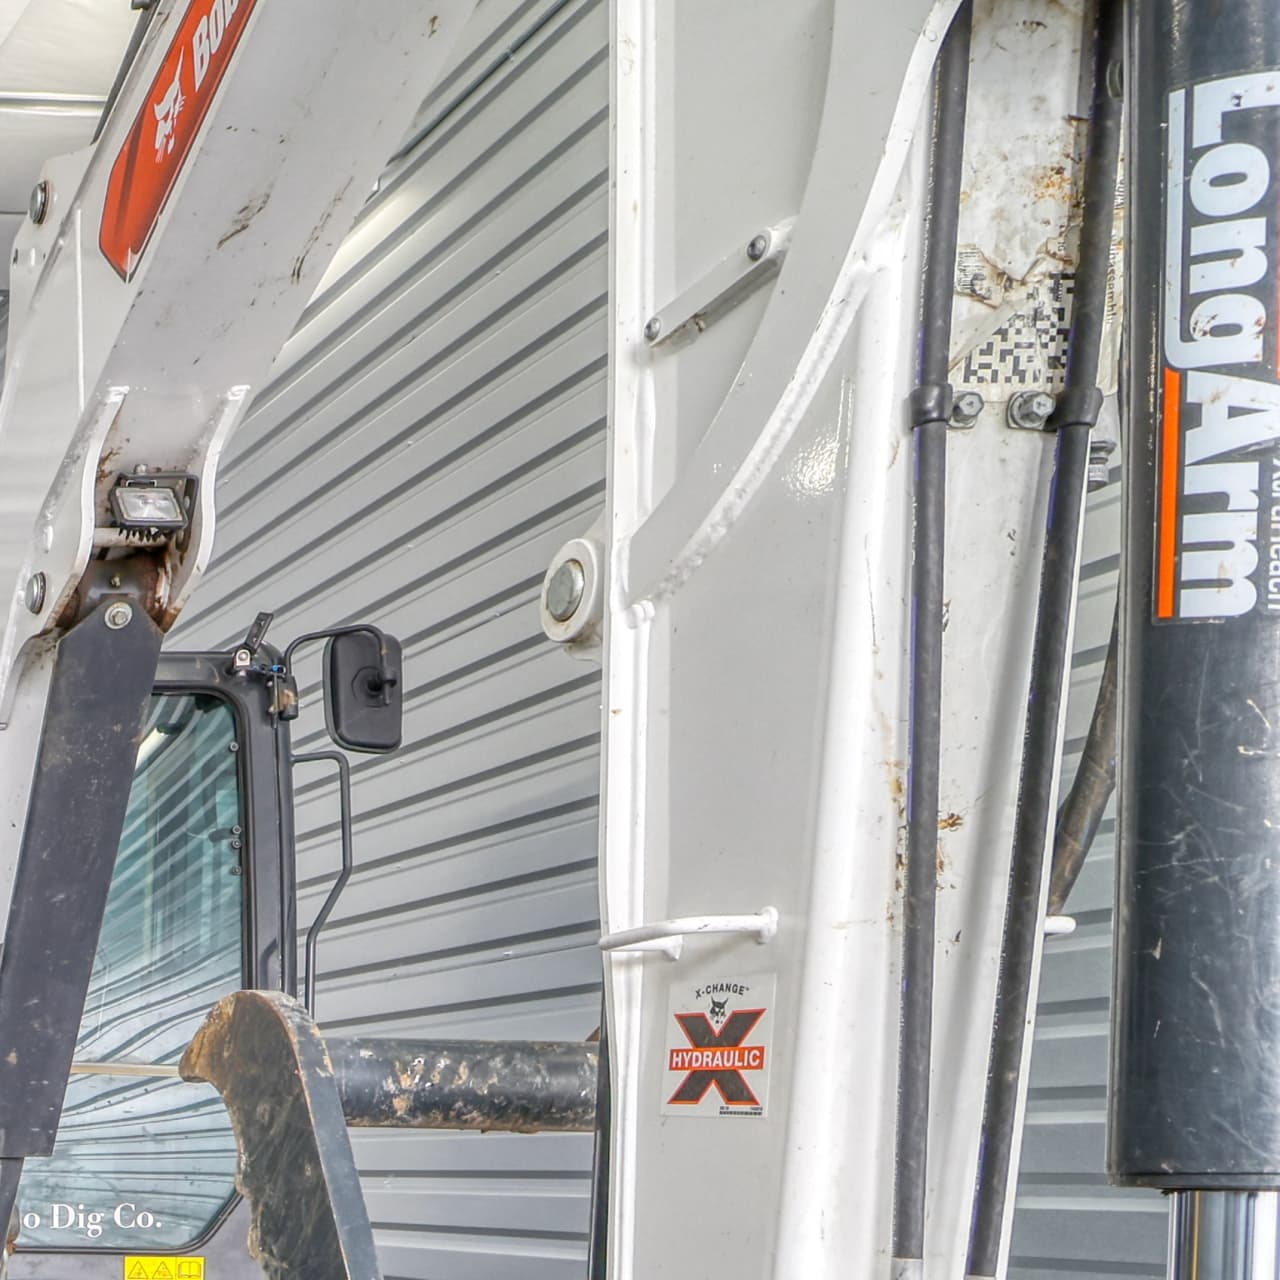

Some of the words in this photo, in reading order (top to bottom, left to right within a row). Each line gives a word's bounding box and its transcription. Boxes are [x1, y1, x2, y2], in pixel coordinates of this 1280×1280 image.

[671, 1050, 761, 1068] HYDRAULIC
[50, 1203, 105, 1238] Dig
[113, 1202, 163, 1228] Co.
